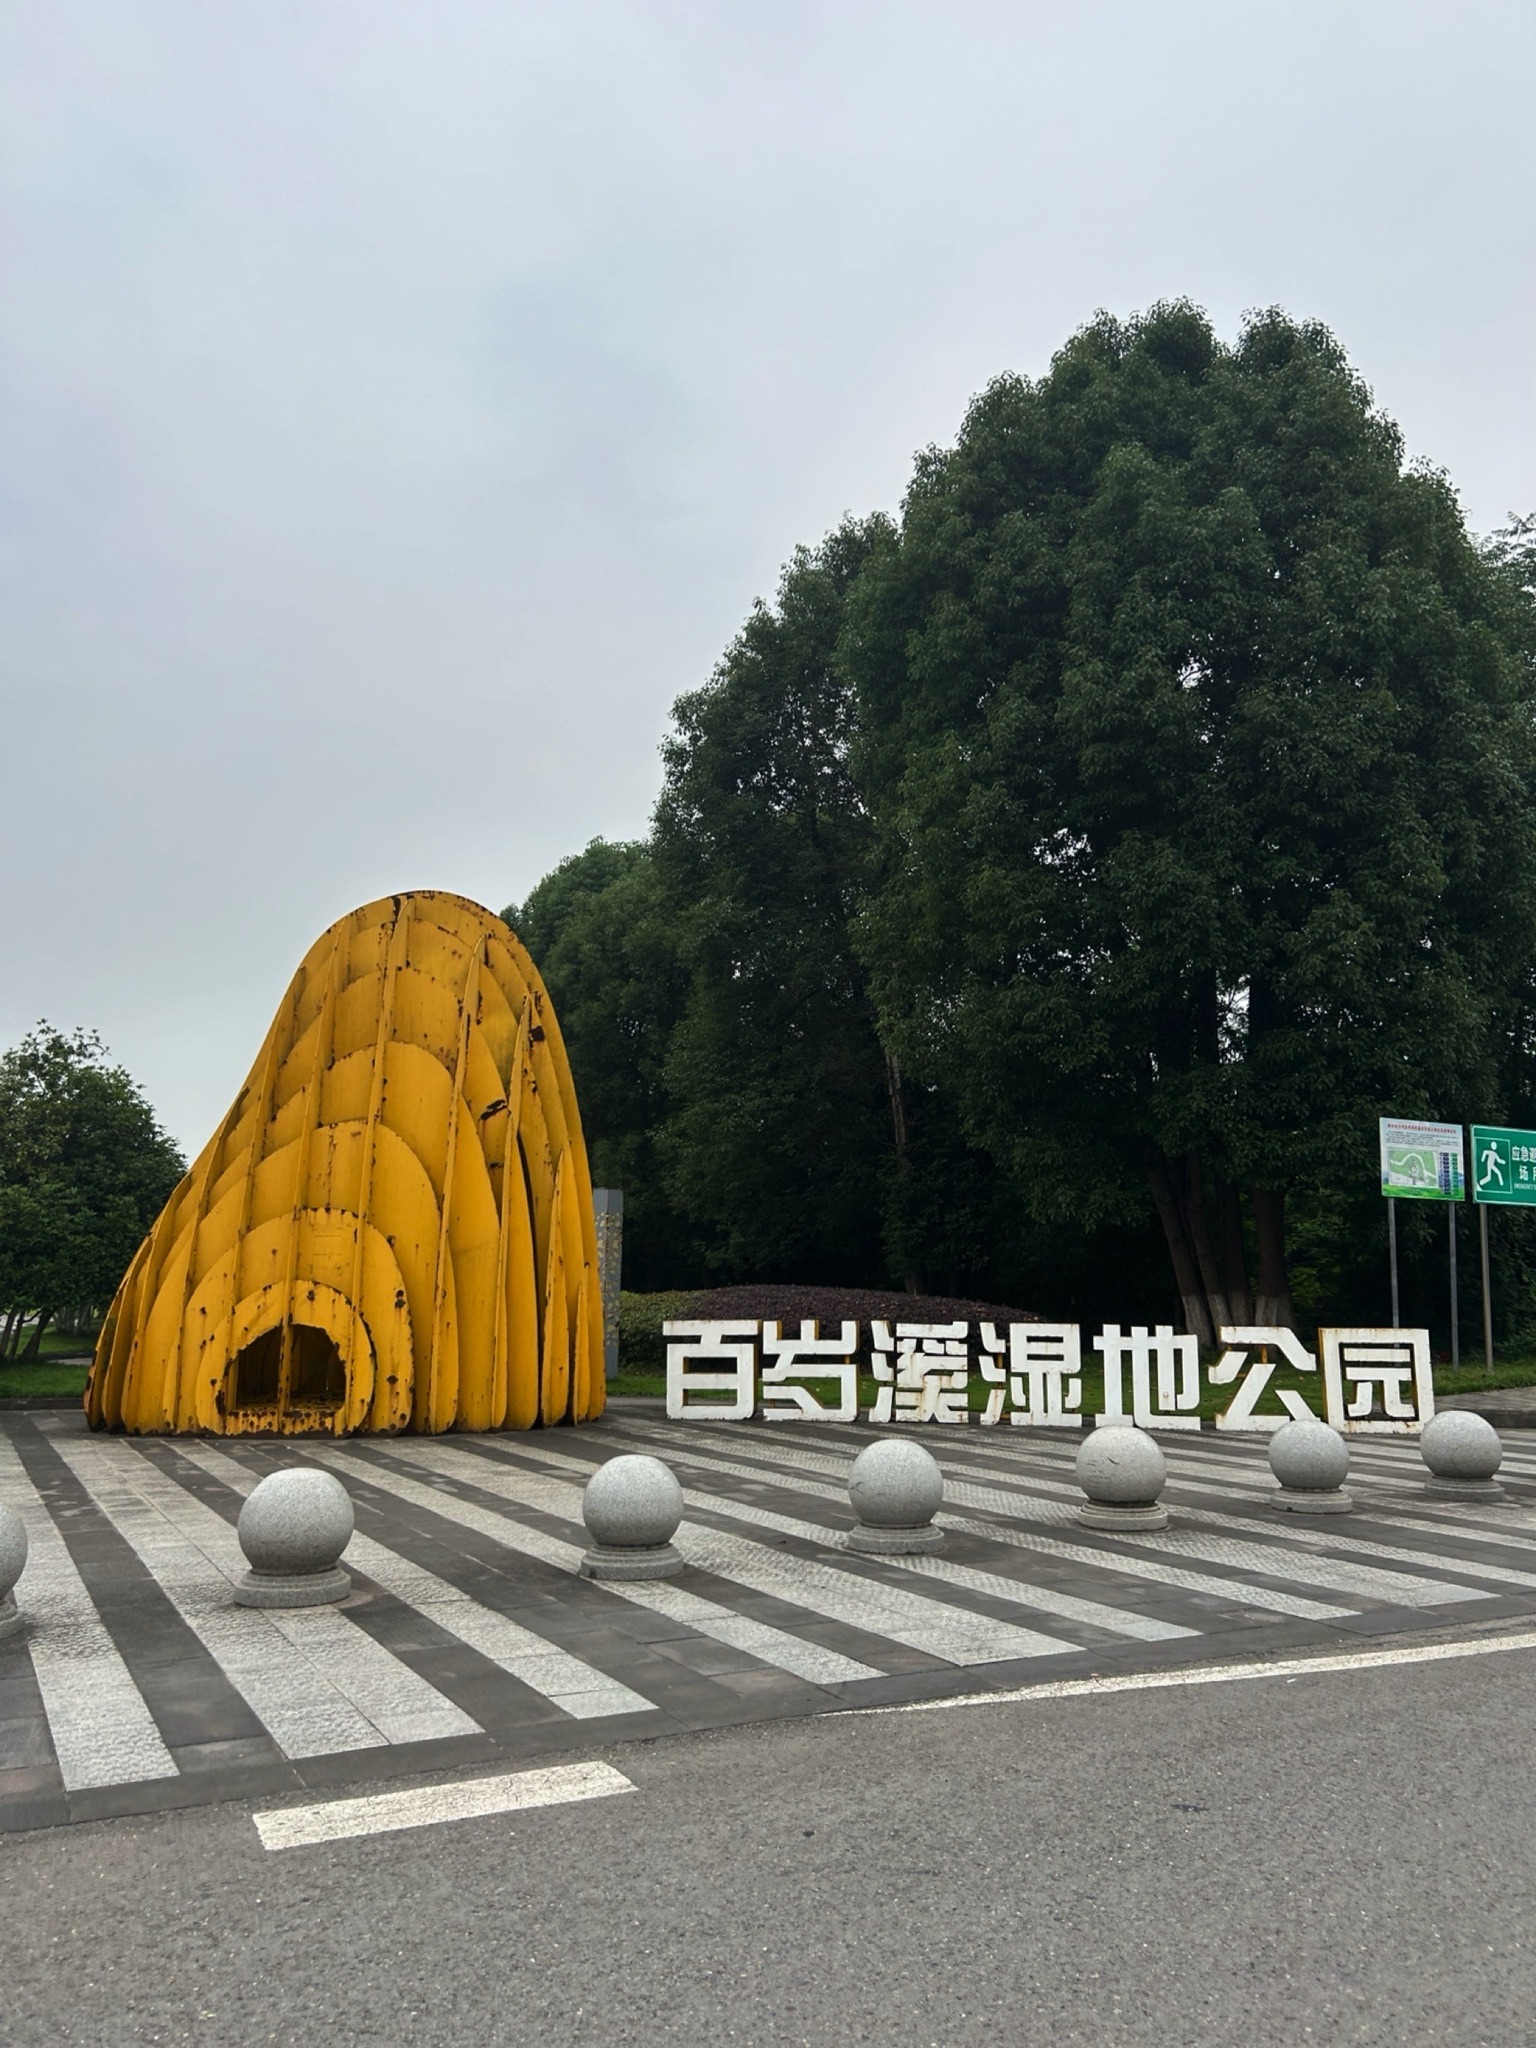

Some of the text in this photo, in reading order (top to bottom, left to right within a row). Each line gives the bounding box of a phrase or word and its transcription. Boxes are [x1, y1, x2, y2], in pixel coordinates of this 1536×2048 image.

[663, 1320, 1435, 1434] 百岁溪湿地公园
